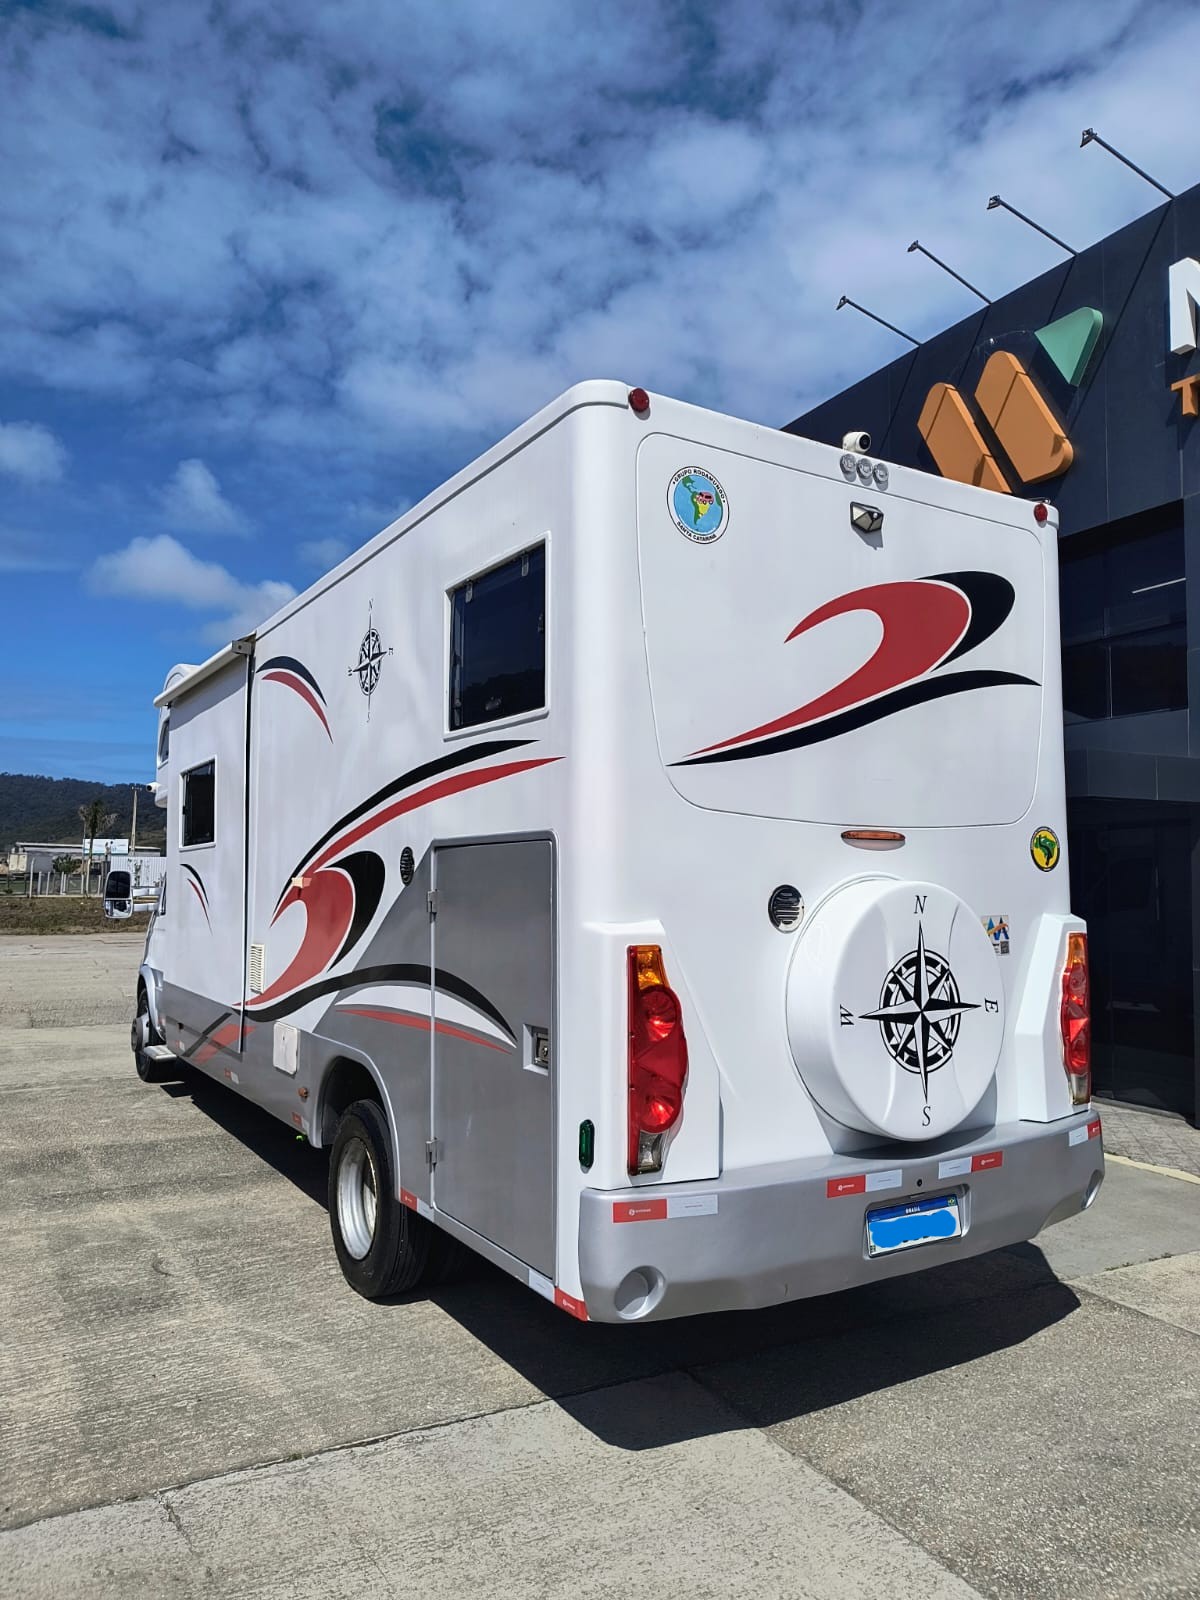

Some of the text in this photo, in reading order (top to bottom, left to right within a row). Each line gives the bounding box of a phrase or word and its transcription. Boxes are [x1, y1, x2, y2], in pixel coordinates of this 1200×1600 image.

[674, 468, 725, 499] GRUPO RODAMUNDO
[676, 521, 717, 541] SANTA CATARINA
[914, 895, 927, 914] N
[839, 1003, 855, 1028] W
[984, 998, 999, 1013] E
[922, 1105, 931, 1127] S
[905, 1206, 920, 1214] BRASIL
